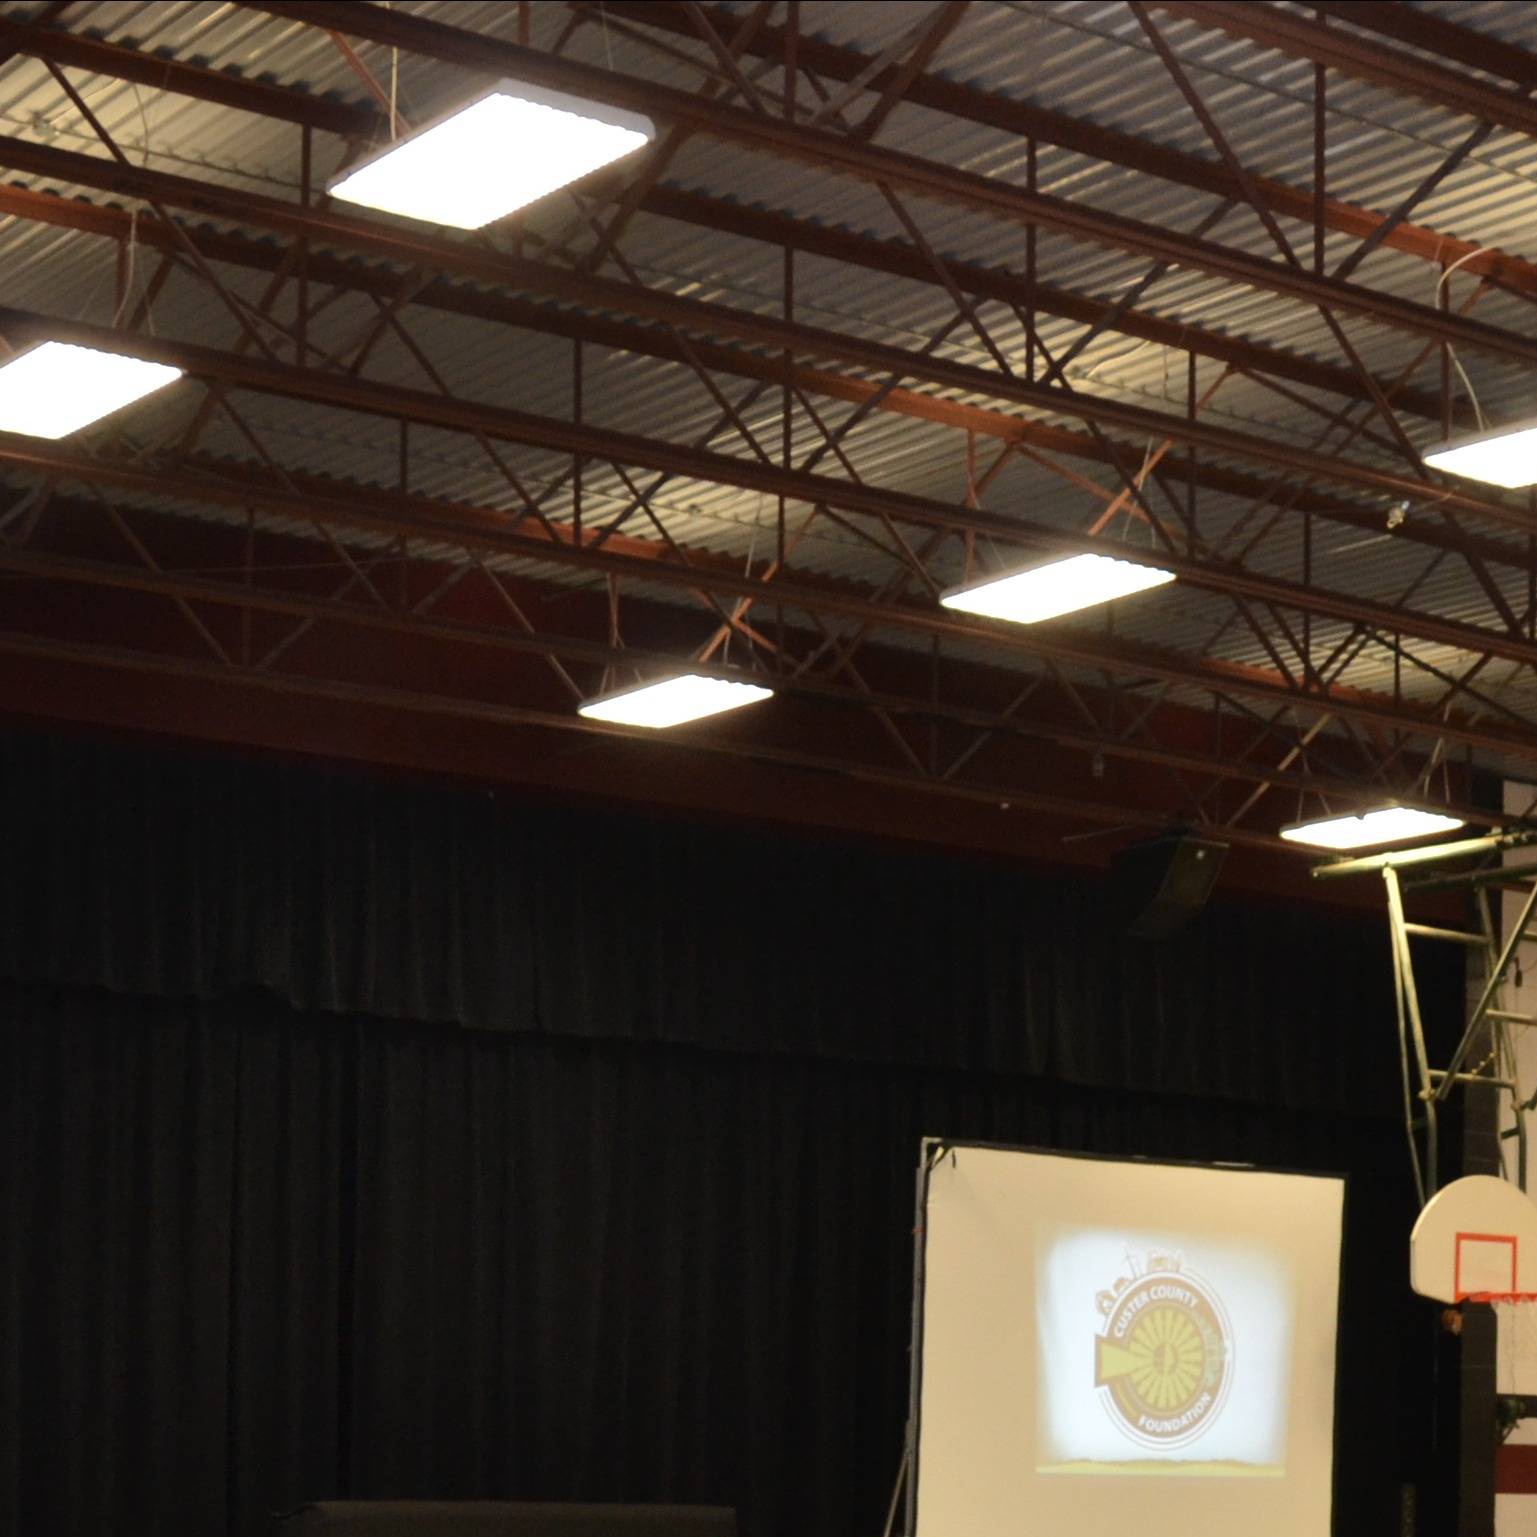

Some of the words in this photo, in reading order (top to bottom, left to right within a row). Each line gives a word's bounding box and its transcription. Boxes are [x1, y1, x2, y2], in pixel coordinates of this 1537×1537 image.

[1114, 1291, 1151, 1338] CUSTER
[1150, 1285, 1199, 1308] COUNTY
[1138, 1391, 1211, 1432] FOUNDATION
